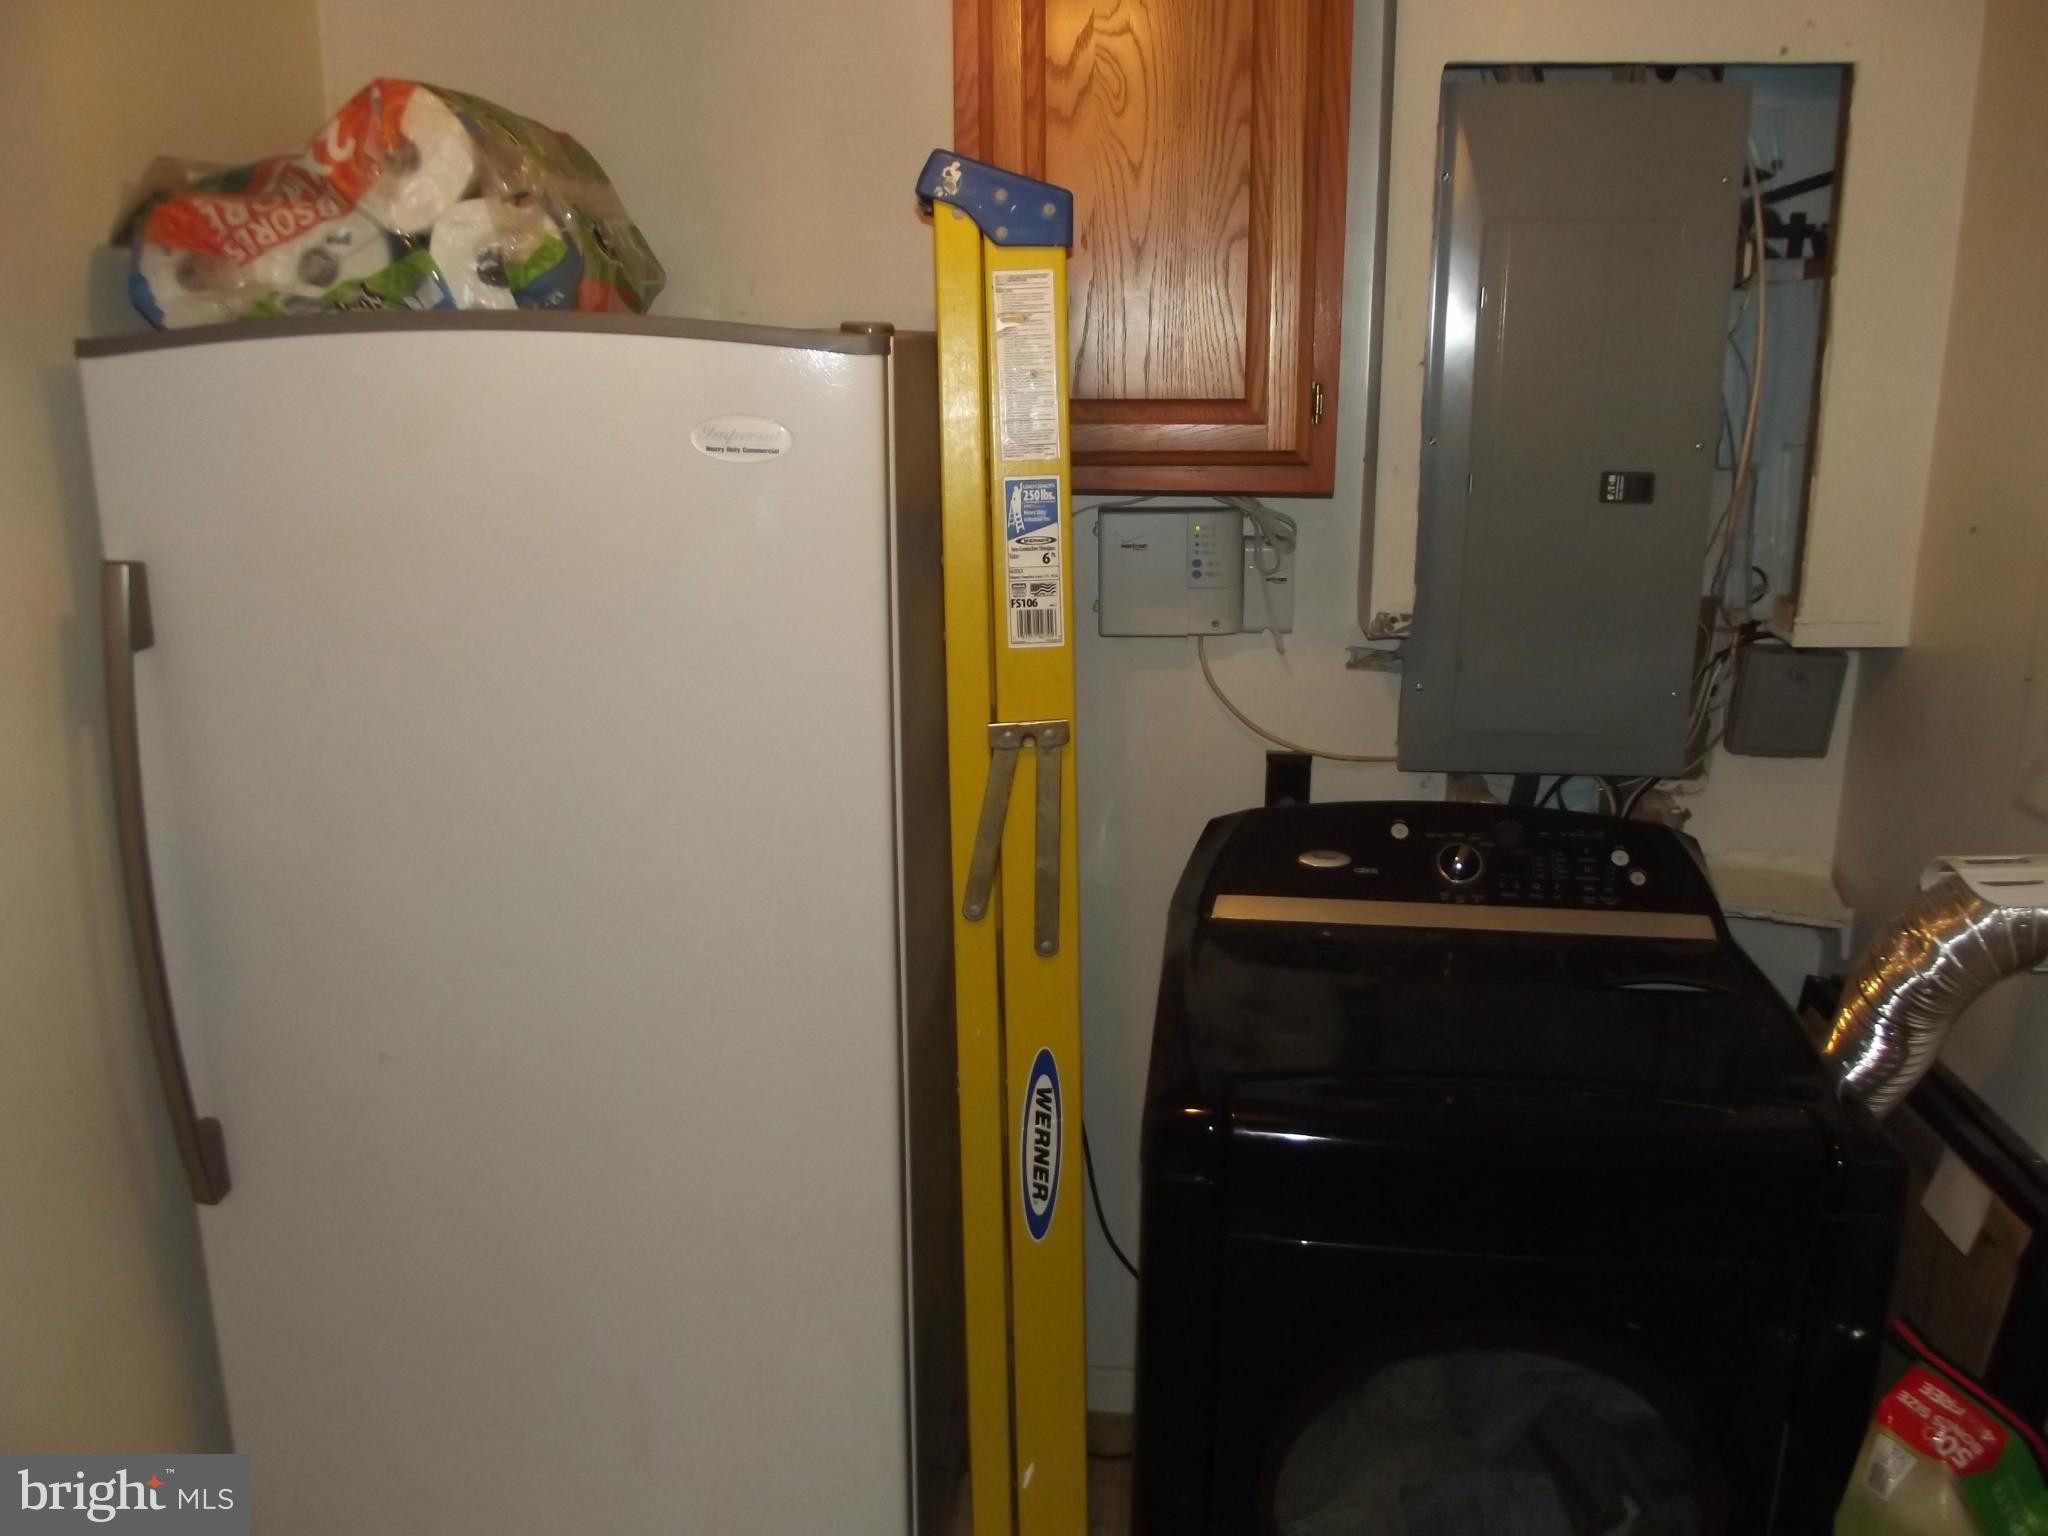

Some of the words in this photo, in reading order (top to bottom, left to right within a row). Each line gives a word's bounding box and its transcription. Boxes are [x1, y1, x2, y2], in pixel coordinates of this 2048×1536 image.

[726, 446, 740, 454] Duty
[742, 446, 780, 455] Commercial
[1023, 490, 1040, 501] 250
[1041, 489, 1056, 501] lbs.
[1042, 552, 1051, 564] 6
[1011, 598, 1038, 608] FS106
[1032, 1087, 1053, 1202] WERNER
